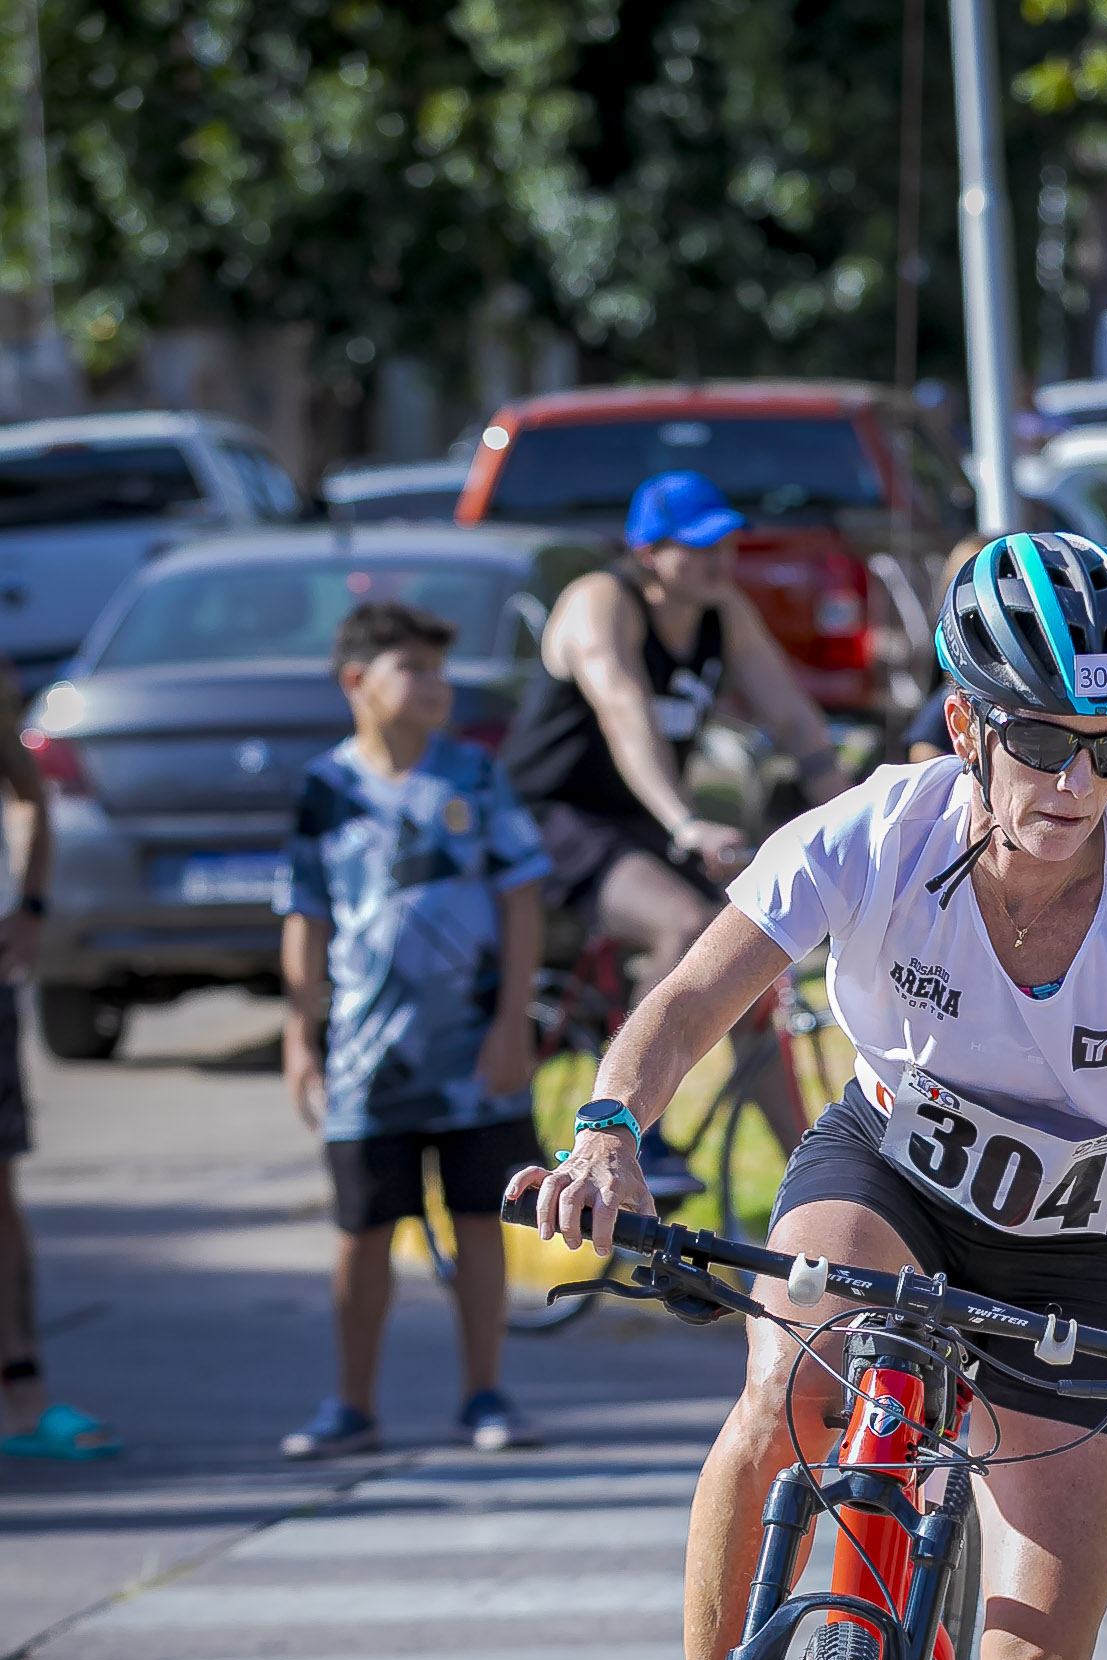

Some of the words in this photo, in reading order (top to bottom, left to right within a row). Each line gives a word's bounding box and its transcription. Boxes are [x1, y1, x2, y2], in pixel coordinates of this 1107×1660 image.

[944, 611, 968, 668] RUDY
[908, 957, 951, 984] ROSARIO
[889, 960, 962, 1019] ARENA
[827, 1273, 873, 1289] ITTER
[967, 1305, 1029, 1327] TWITTER
